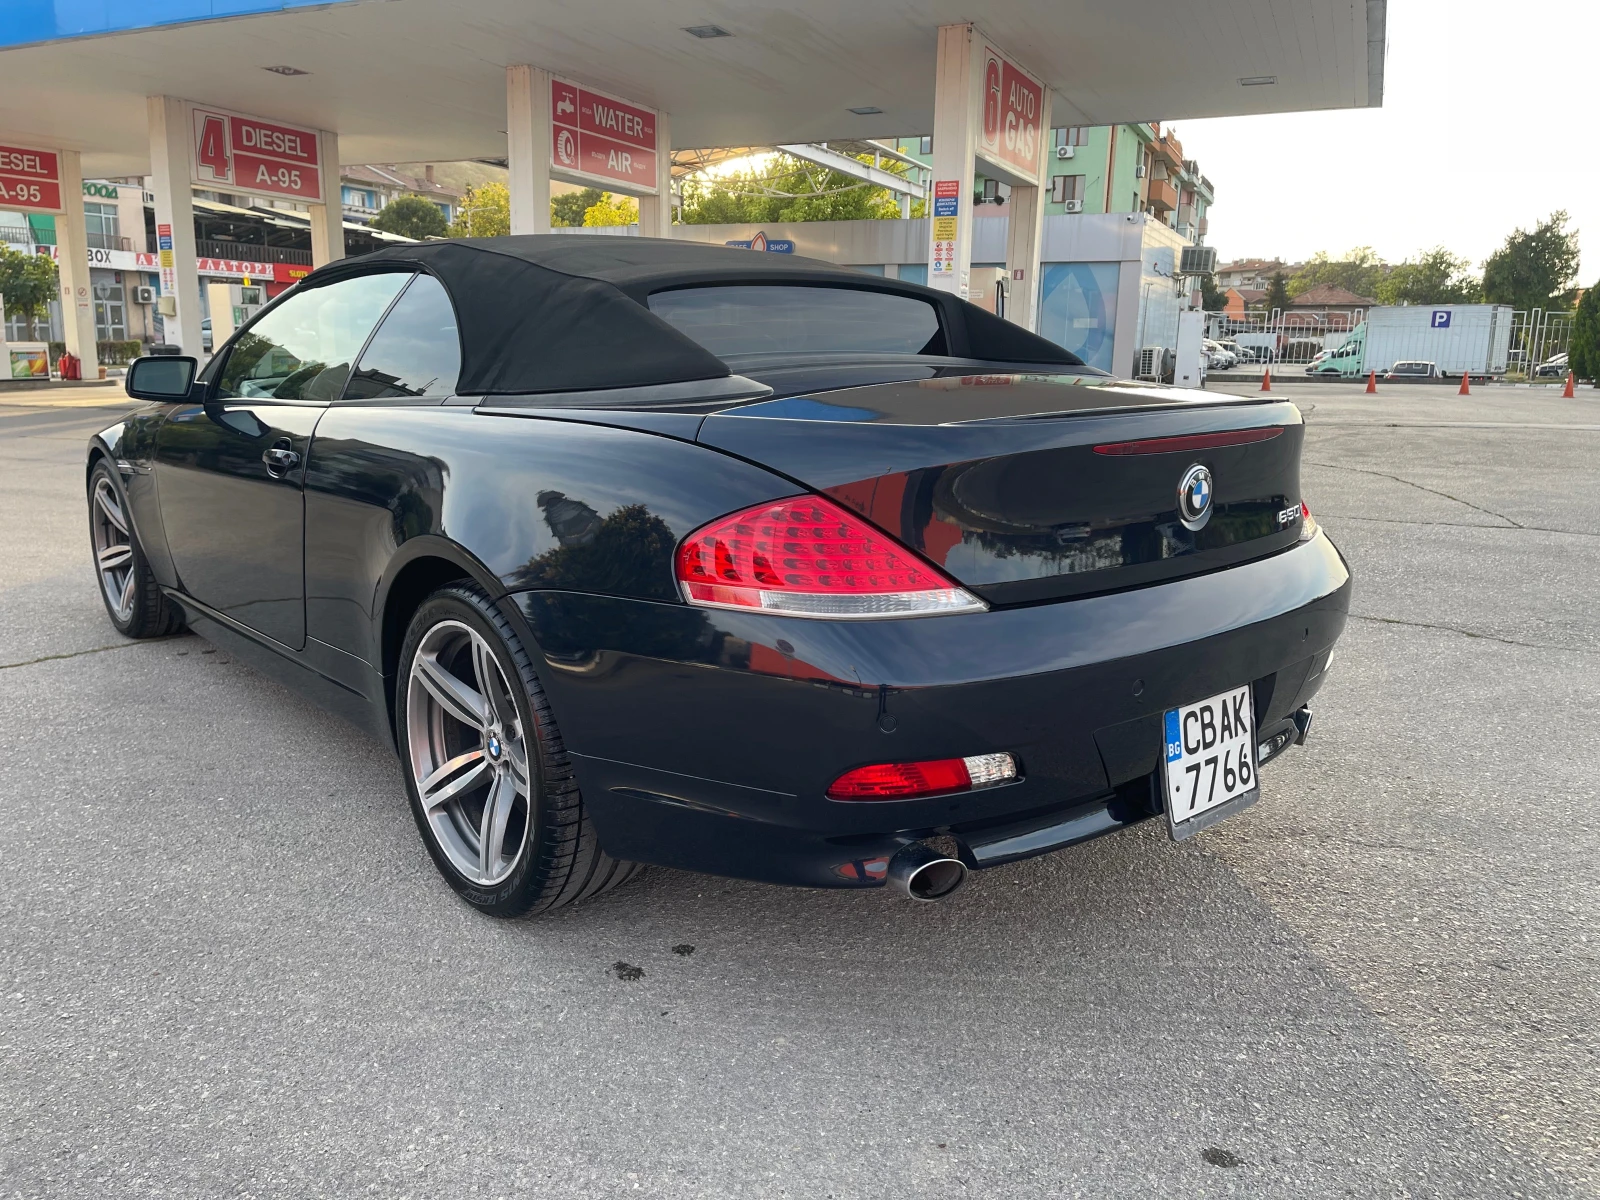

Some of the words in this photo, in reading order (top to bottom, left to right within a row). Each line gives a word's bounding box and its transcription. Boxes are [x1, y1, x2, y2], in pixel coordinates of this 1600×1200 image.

[986, 57, 1000, 146] 6
[1009, 80, 1034, 120] AUTO
[593, 102, 643, 138] WATER
[1005, 110, 1034, 160] GAS
[198, 115, 230, 180] 4
[242, 125, 308, 157] DIESEL
[256, 164, 301, 189] A-95
[608, 149, 632, 174] AIR
[1435, 312, 1447, 326] P
[1168, 742, 1180, 756] BG
[1186, 743, 1250, 810] 7766
